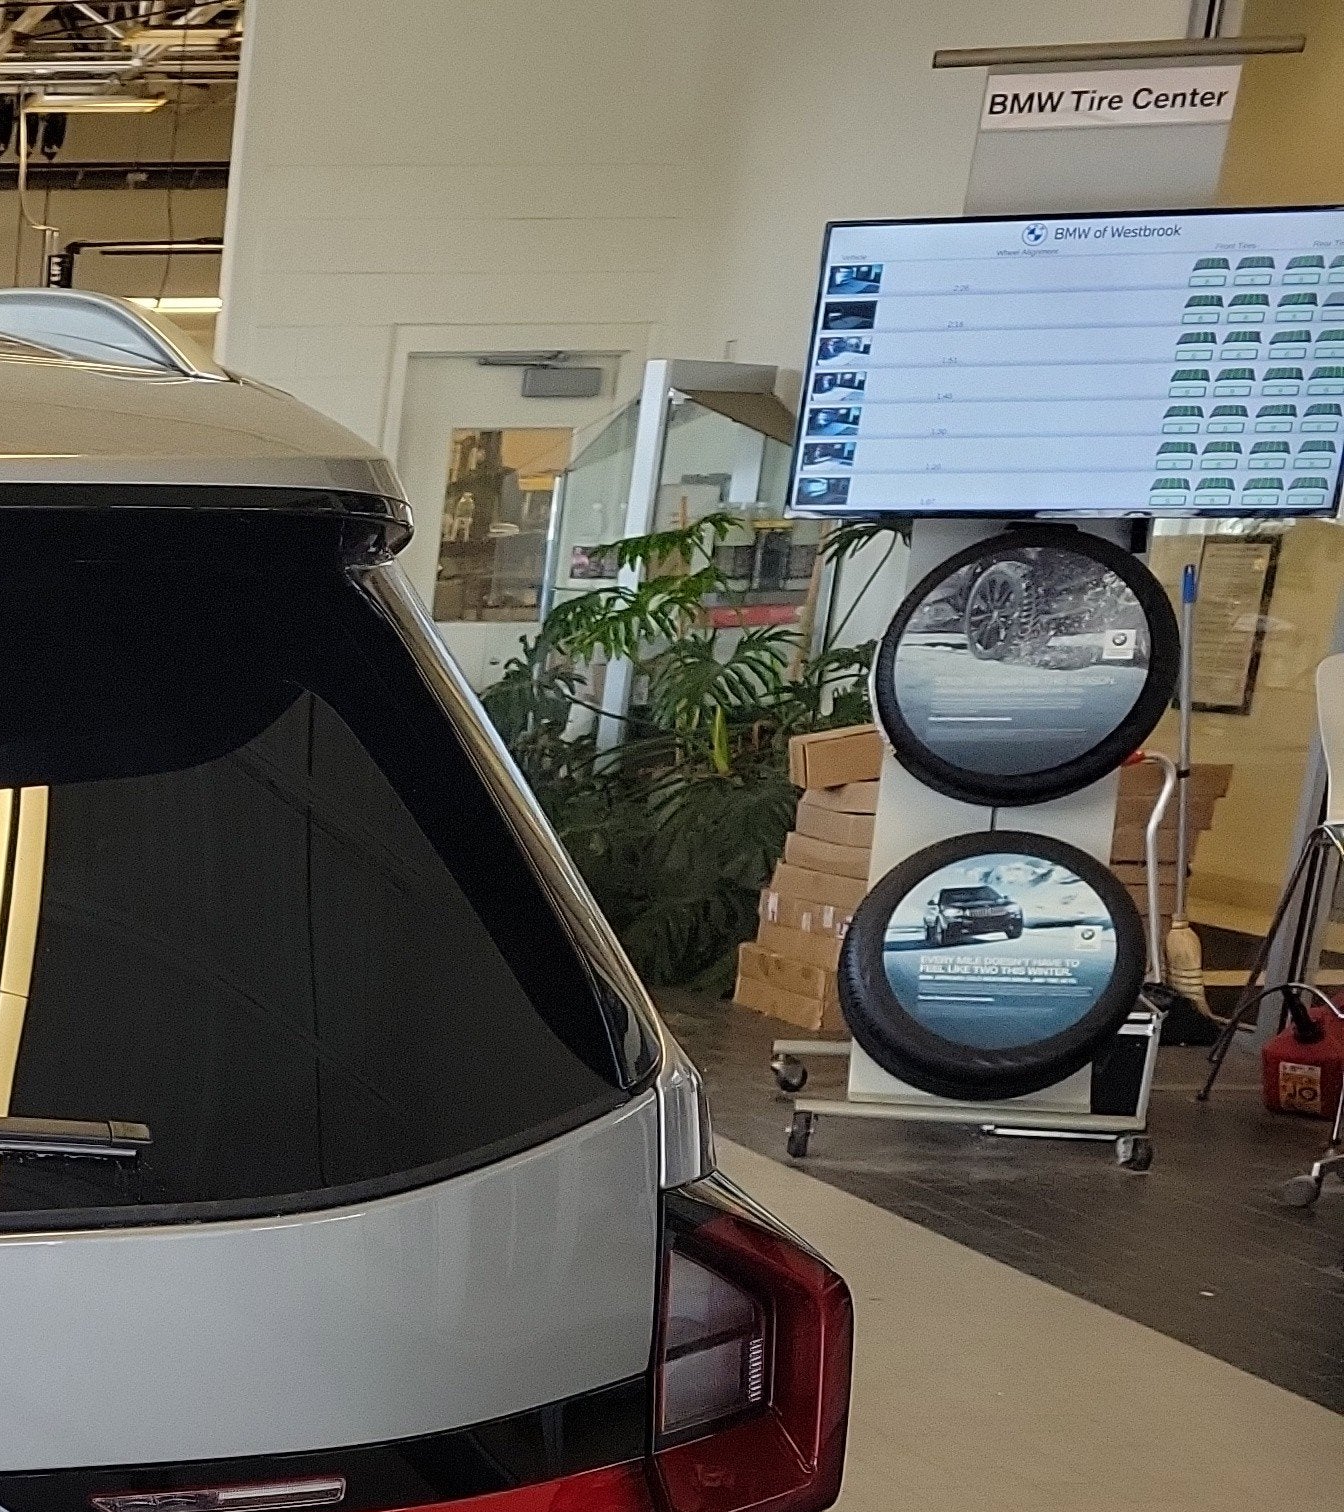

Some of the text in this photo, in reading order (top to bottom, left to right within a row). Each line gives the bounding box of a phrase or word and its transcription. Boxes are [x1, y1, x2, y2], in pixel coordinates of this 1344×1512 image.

[988, 87, 1229, 115] BMW Tire Center
[1054, 227, 1091, 240] BMW
[1094, 225, 1109, 239] of
[1111, 225, 1182, 238] Westbrook
